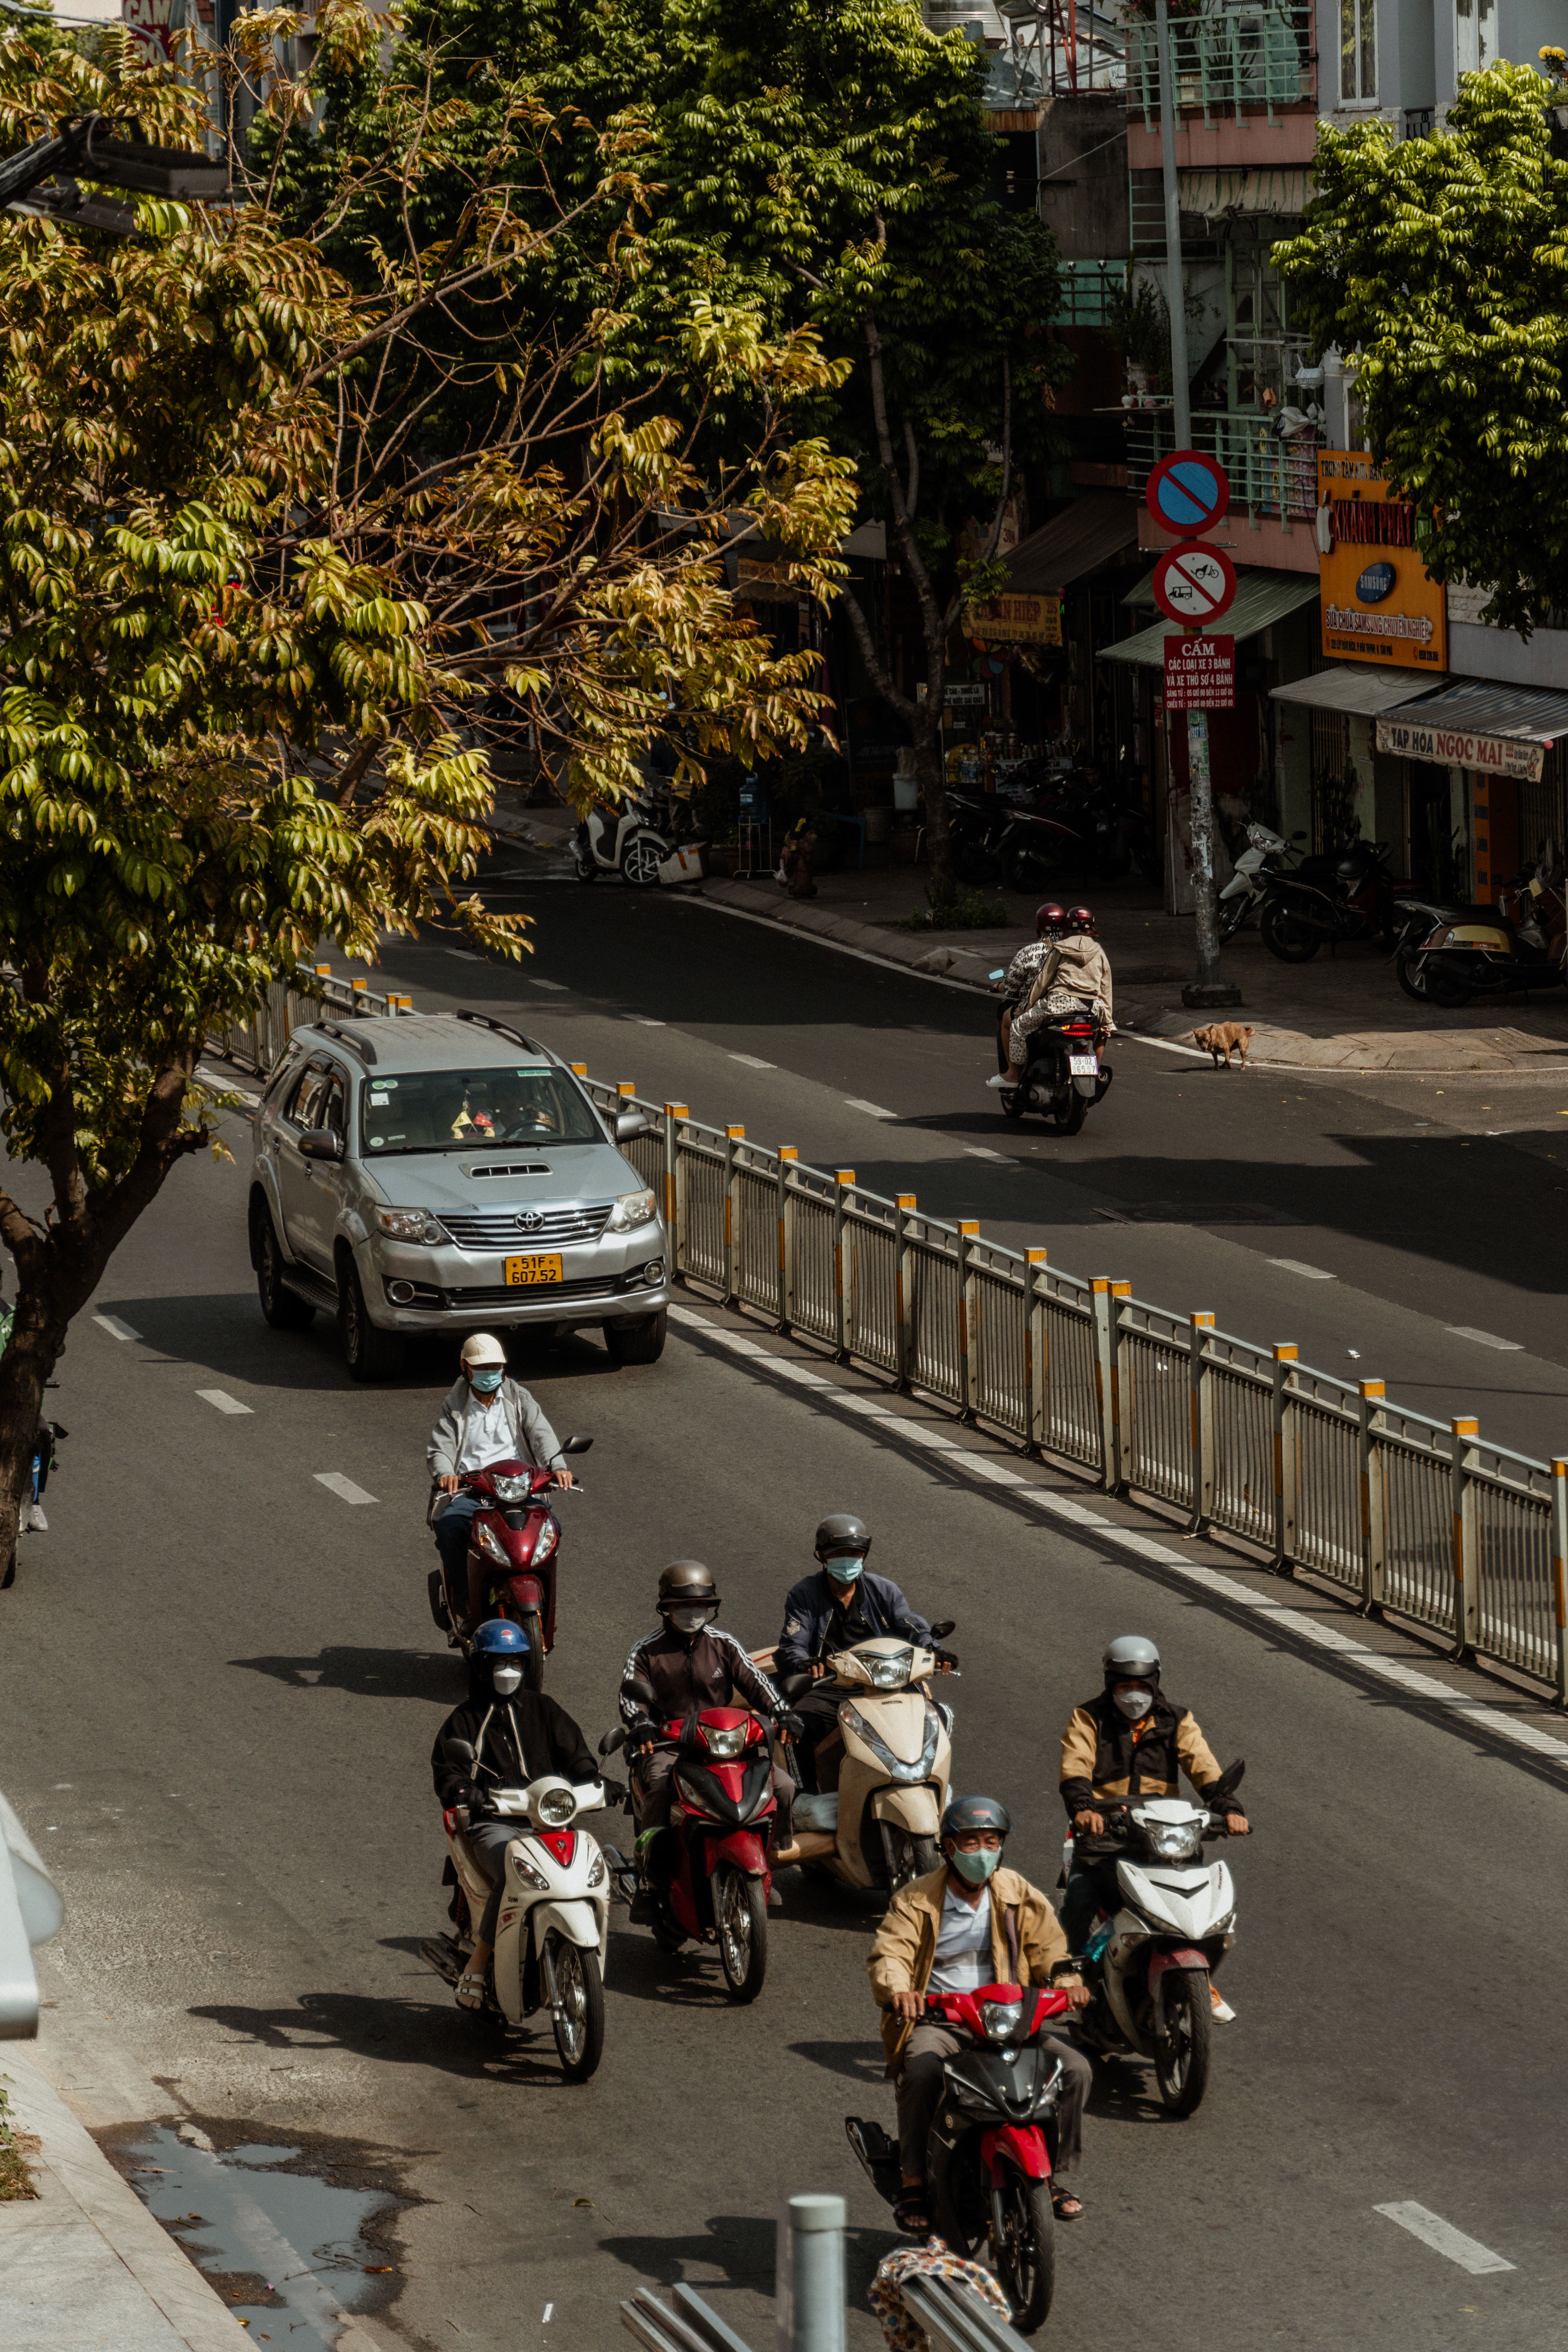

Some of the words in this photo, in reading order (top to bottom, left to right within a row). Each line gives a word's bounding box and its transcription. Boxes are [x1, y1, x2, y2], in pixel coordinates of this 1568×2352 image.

[1321, 459, 1341, 477] TRUNG
[1341, 455, 1354, 478] TÂM
[1361, 575, 1387, 591] SAMSUNG
[1355, 614, 1382, 634] SAMSUNG
[1181, 637, 1215, 656] CẤM
[1169, 657, 1181, 670] CÁC
[1183, 659, 1197, 672] LOẠI
[1198, 659, 1206, 670] XE
[1208, 659, 1212, 670] 3
[1214, 655, 1230, 669] BÁNH
[1167, 672, 1175, 686] VÀ
[1176, 675, 1185, 686] XE
[1186, 672, 1199, 686] THÔ
[1201, 673, 1209, 685] SƠ
[1210, 674, 1215, 685] 4
[1216, 671, 1232, 685] BÁNH
[1167, 688, 1177, 697] SÁNG
[1206, 686, 1214, 696] ĐẾN
[1167, 698, 1178, 708] CHIỀU
[1206, 697, 1214, 707] ĐẾN
[1412, 728, 1433, 753] HÓA
[1436, 733, 1473, 764] NGỌC
[1476, 739, 1503, 766] MAI
[522, 1257, 545, 1269] 51F
[512, 1269, 556, 1283] 607.52
